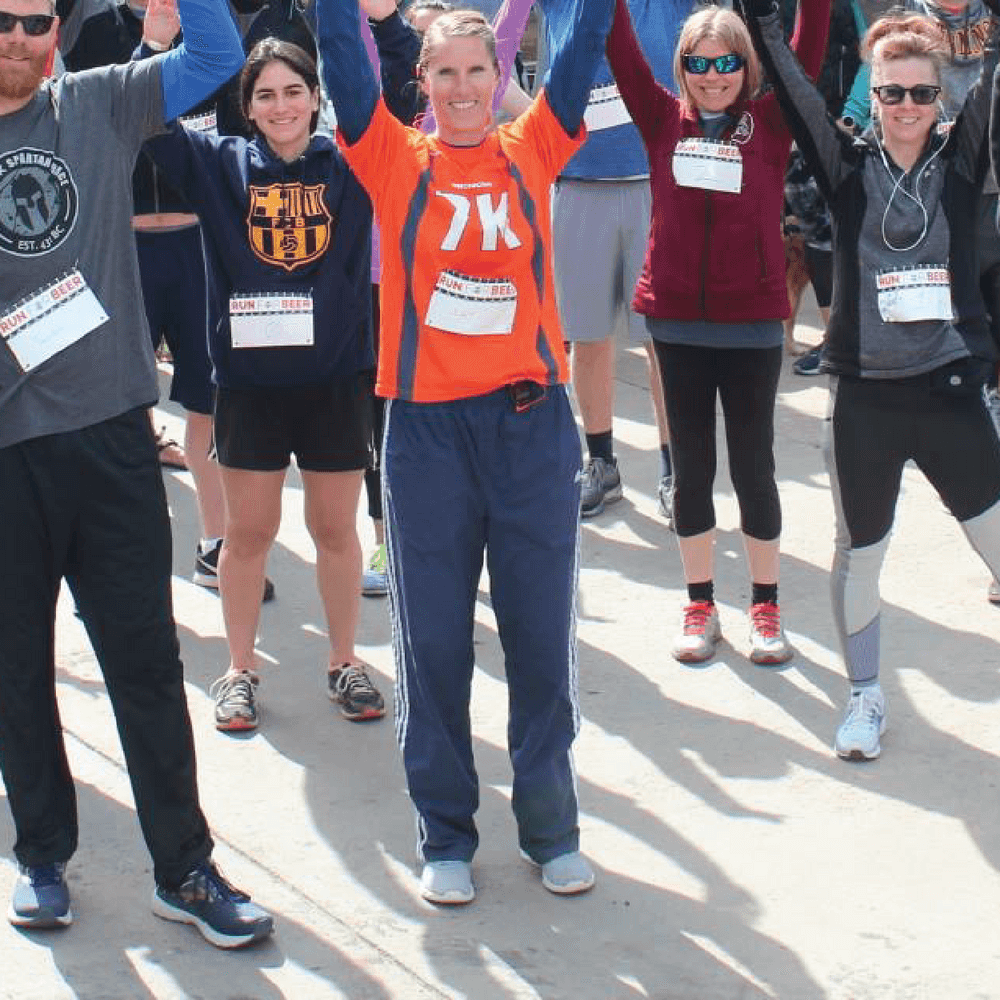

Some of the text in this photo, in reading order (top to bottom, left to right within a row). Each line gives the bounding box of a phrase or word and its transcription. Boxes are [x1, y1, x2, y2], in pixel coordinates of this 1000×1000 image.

[435, 190, 521, 251] 7K
[18, 240, 39, 251] EST.
[439, 275, 463, 292] RUN
[879, 273, 900, 286] RUN
[50, 275, 82, 301] BEER
[230, 301, 255, 311] RUN
[280, 299, 312, 310] BEER
